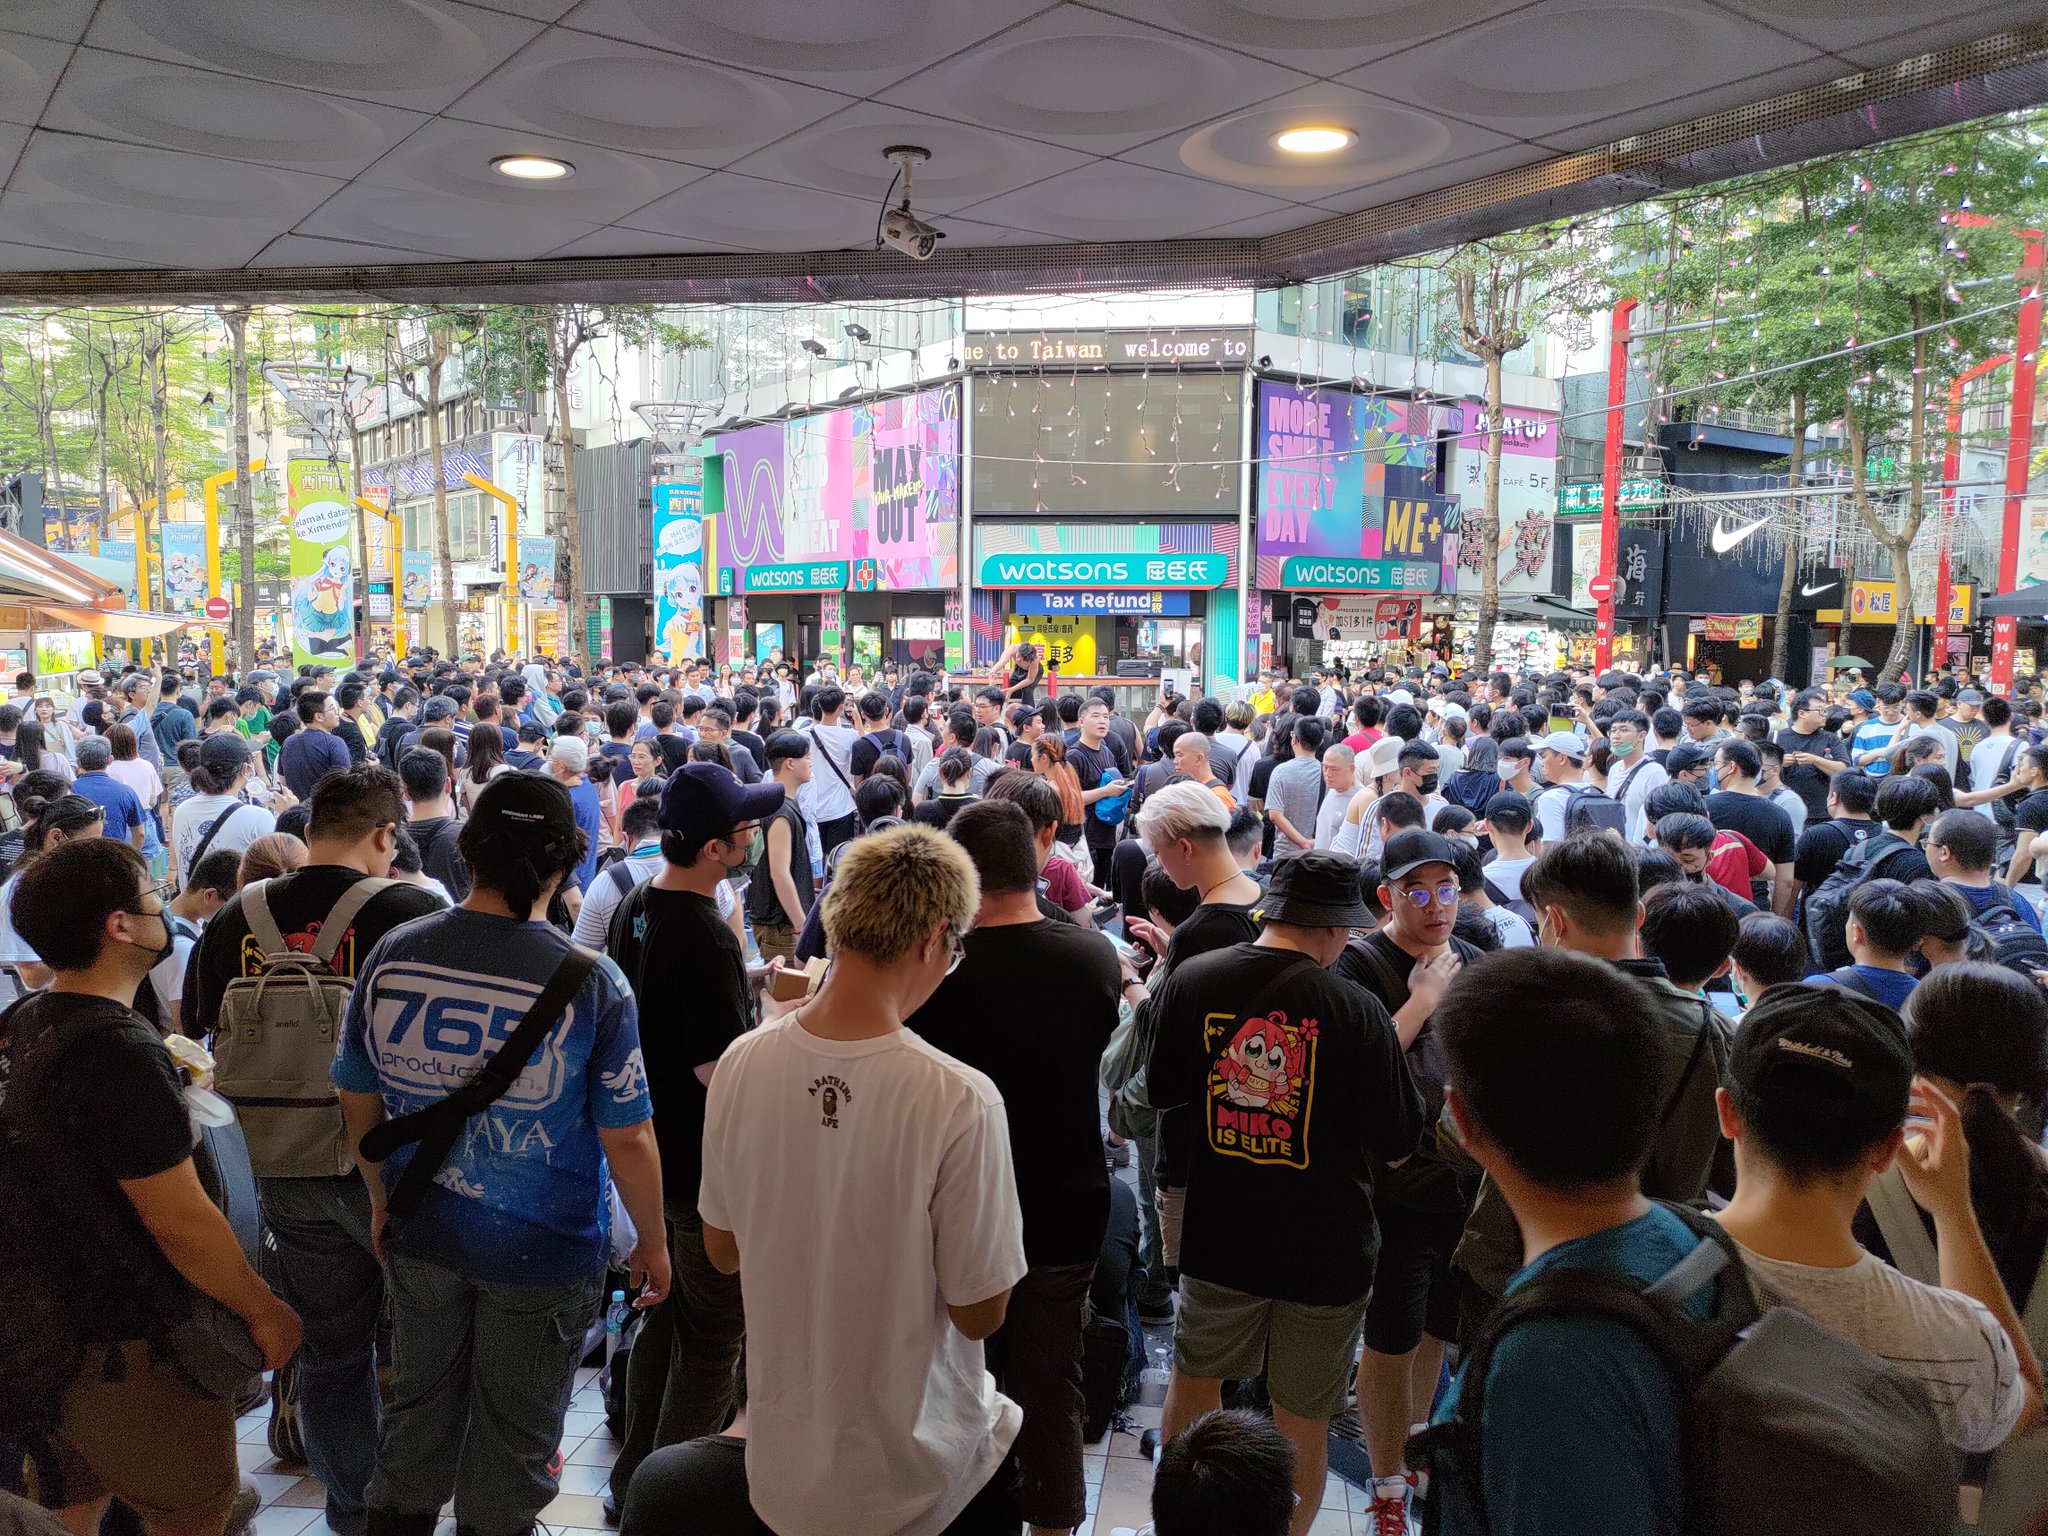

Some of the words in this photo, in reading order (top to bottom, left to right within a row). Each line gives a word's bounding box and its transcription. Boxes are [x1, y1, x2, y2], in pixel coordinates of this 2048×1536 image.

[996, 342, 1019, 360] to
[1031, 340, 1103, 359] Taiwan
[1125, 339, 1210, 357] welcome
[1224, 340, 1247, 356] to
[1268, 396, 1331, 438] MORE
[1475, 413, 1521, 436] MAT
[1525, 418, 1547, 438] UP
[1267, 433, 1335, 474] SMILE
[873, 444, 922, 495] MAX
[893, 479, 924, 501] MAKEUP
[1266, 470, 1339, 510] EVERY
[1529, 473, 1549, 489] 5F
[292, 512, 327, 530] Selamat
[876, 493, 919, 544] OUT
[1265, 507, 1311, 544] DAY
[1384, 500, 1442, 556] ME+
[296, 529, 307, 539] ke
[750, 569, 804, 587] watsons
[810, 566, 839, 585] 屈臣氏
[998, 560, 1129, 581] watsons
[1145, 559, 1209, 581] 屈臣氏
[1295, 564, 1381, 584] watsons
[1390, 566, 1429, 586] 屈臣氏
[1042, 592, 1075, 608] Tax
[1081, 592, 1150, 608] Refund
[1868, 590, 1890, 613] 松屋
[1596, 622, 1606, 630] W
[1996, 623, 2009, 633] W
[1596, 638, 1606, 646] 13
[1994, 642, 2008, 652] 14
[813, 1075, 852, 1104] BATHING
[466, 1112, 557, 1153] AYA
[821, 1116, 839, 1129] APE
[1217, 1103, 1293, 1140] MIKO
[1216, 1127, 1237, 1145] IS
[1241, 1136, 1293, 1157] ELITE
